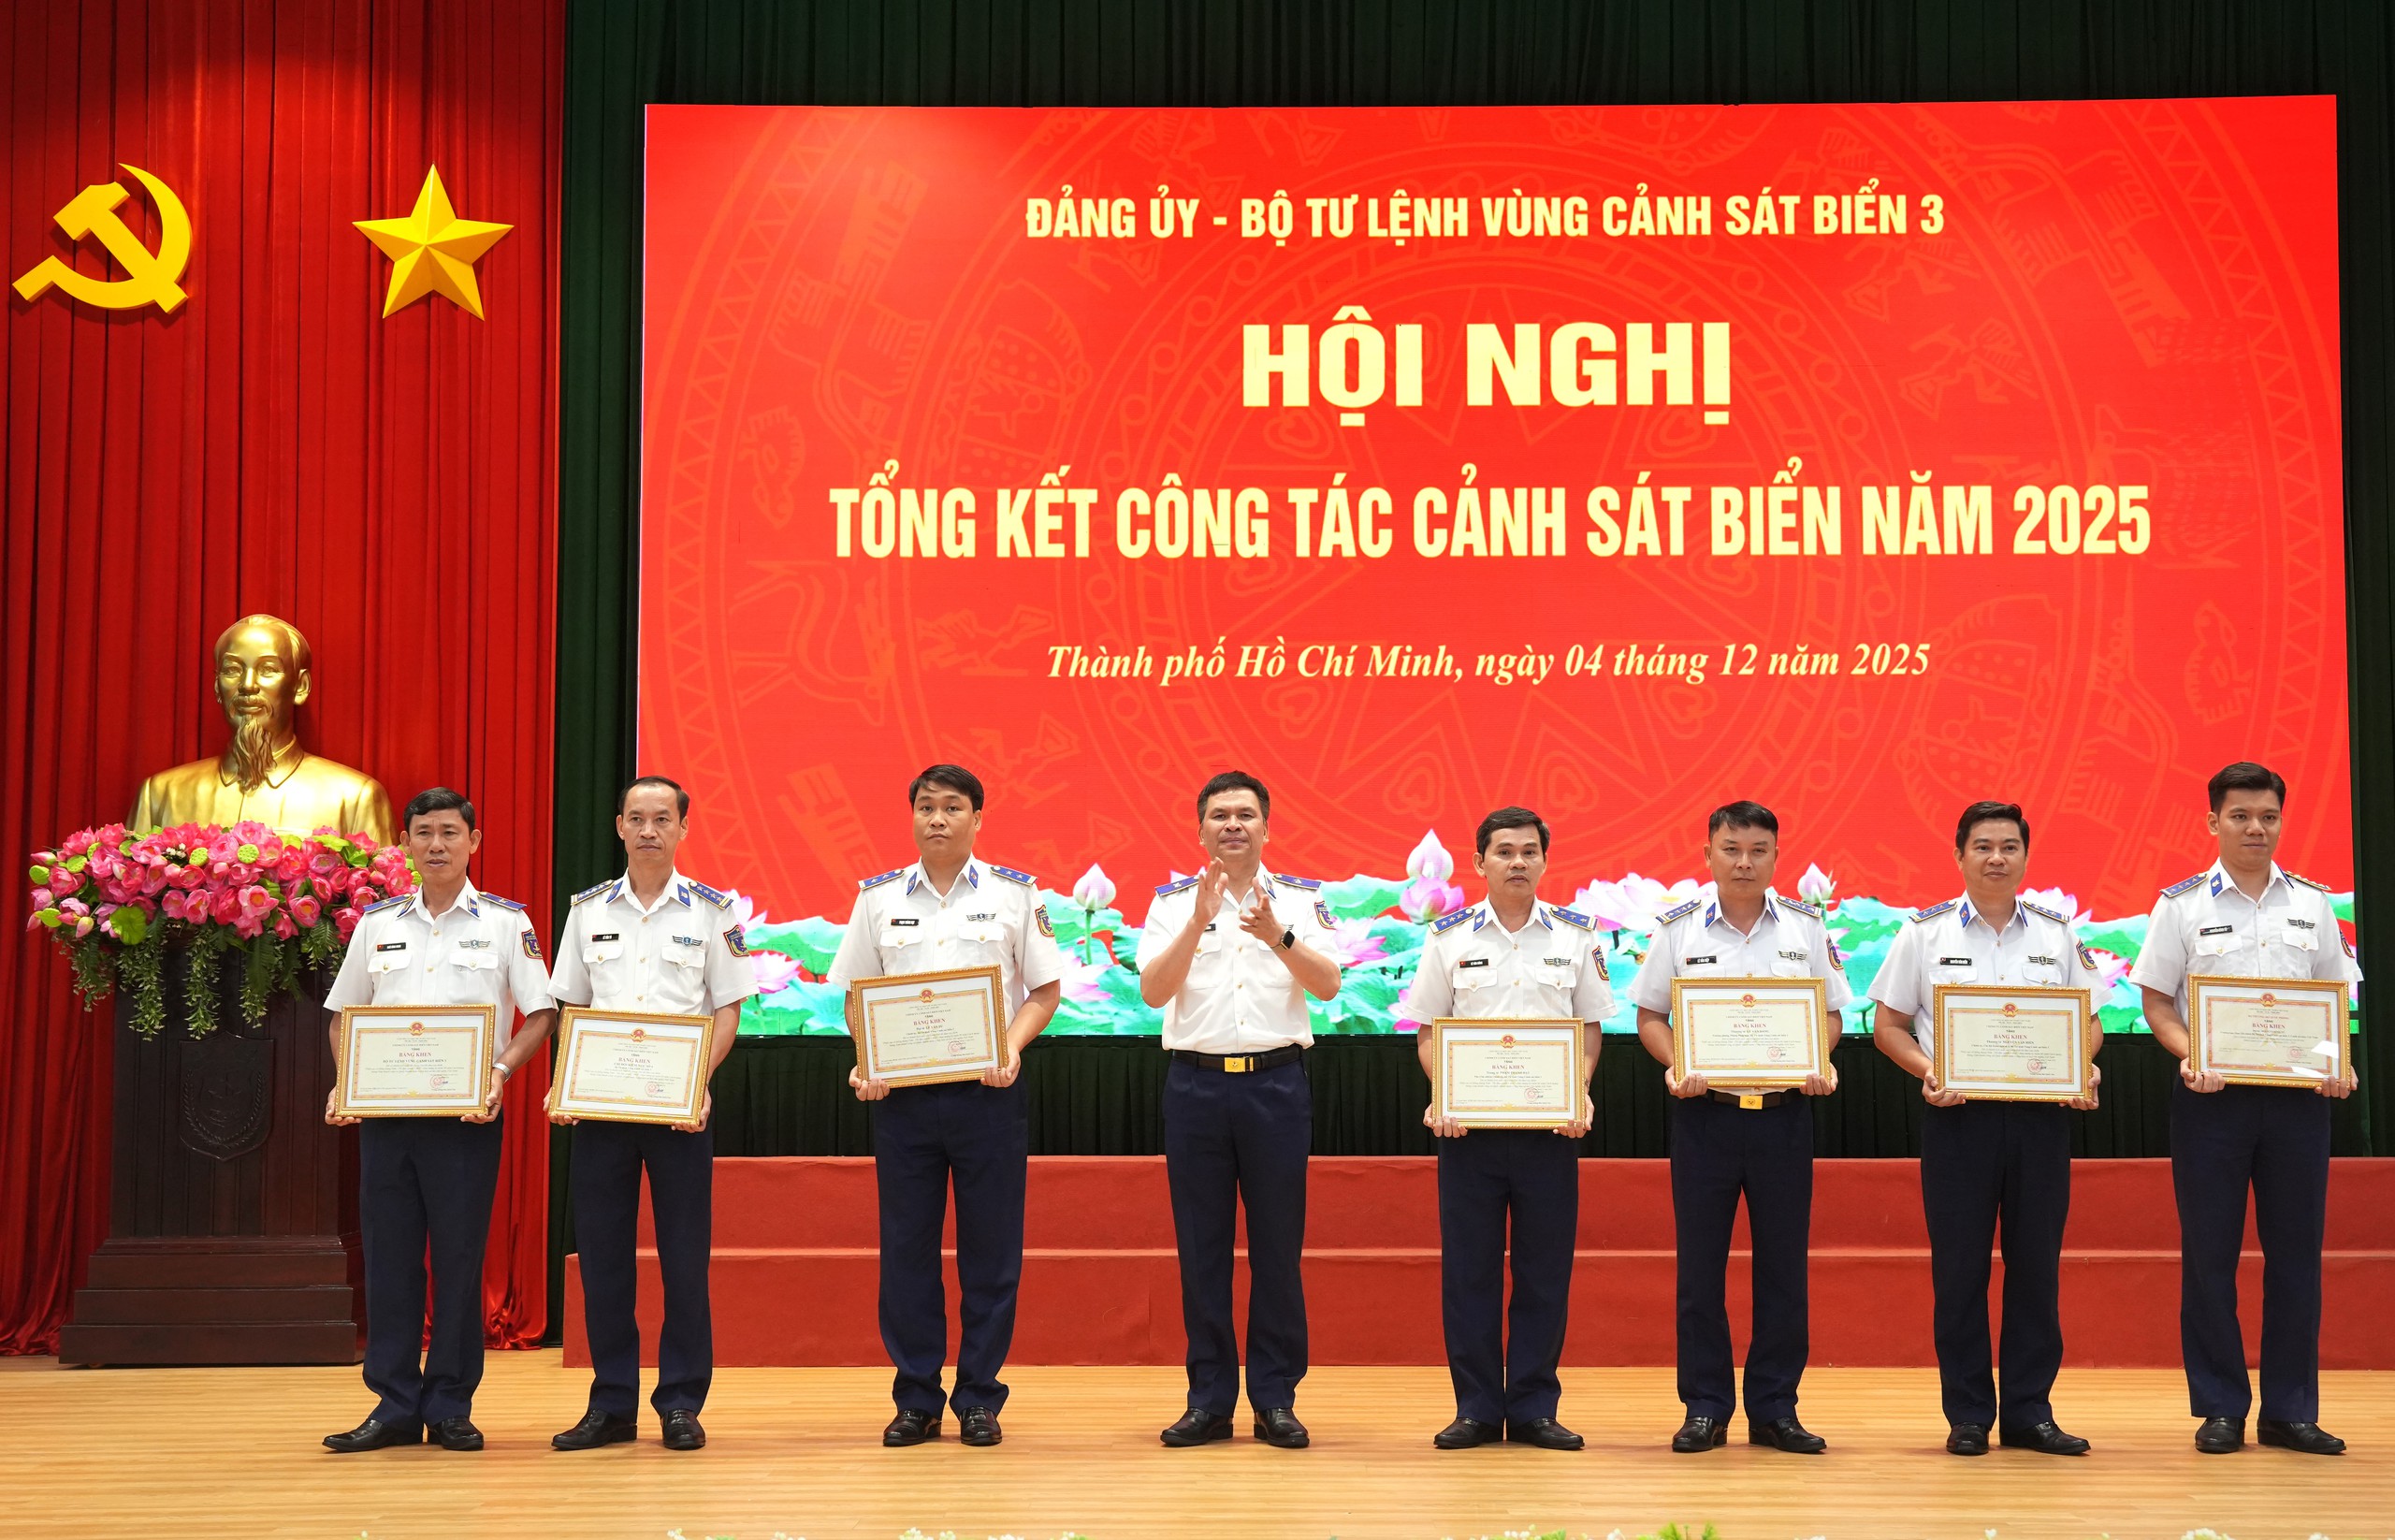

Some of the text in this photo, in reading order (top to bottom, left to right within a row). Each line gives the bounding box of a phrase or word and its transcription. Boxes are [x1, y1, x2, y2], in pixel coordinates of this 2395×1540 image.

[1025, 184, 1136, 239] ĐẢNG
[1150, 185, 1200, 239] ỦY
[1241, 189, 1294, 247] BỘ
[1306, 194, 1359, 239] TƯ
[1368, 189, 1469, 246] LỆNH
[1481, 189, 1589, 238] VÙNG
[1602, 183, 1712, 237] CẢNH
[1725, 187, 1801, 236] SÁT
[1813, 178, 1908, 235] BIỂN
[1920, 194, 1945, 235] 3
[1242, 305, 1731, 428] HỘI NGHỊ
[829, 457, 2151, 559] TỔNG KẾT CÔNG TÁC CẢNH SÁT BIỂN NĂM 2025
[1048, 636, 1931, 687] Thành phố Hồ Chí Minh, ngày 04 tháng 12 năm 2025
